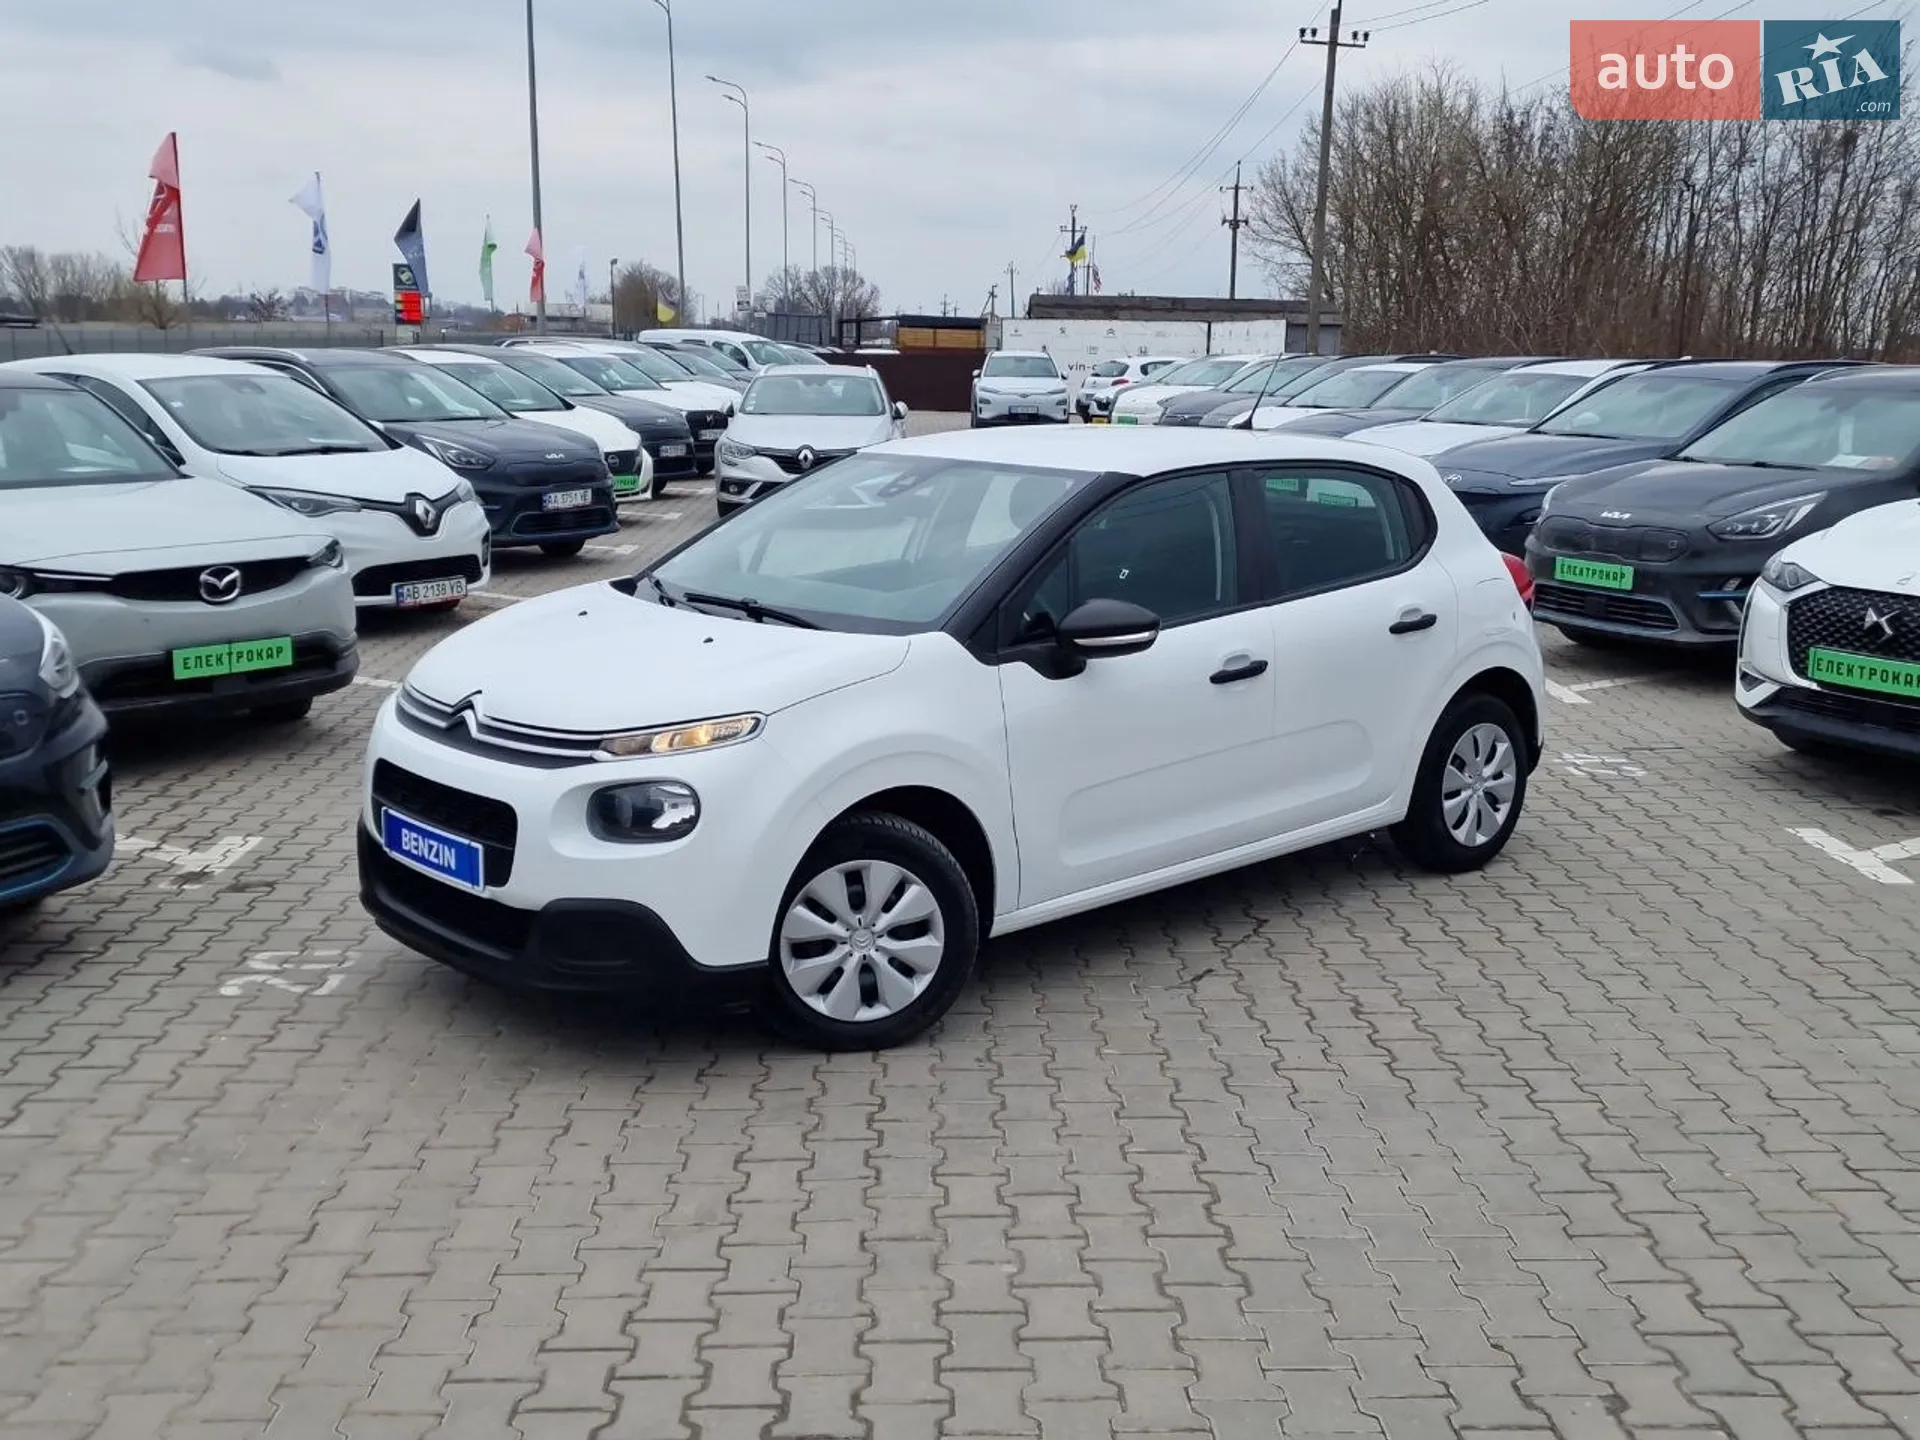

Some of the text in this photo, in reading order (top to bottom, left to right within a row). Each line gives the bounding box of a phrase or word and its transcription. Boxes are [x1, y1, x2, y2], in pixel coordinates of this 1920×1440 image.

[1560, 563, 1626, 582] ЕЛЕКТРОКАР
[183, 645, 284, 671] ЕЛЕКТРОКАР
[401, 827, 456, 871] BENZIN
